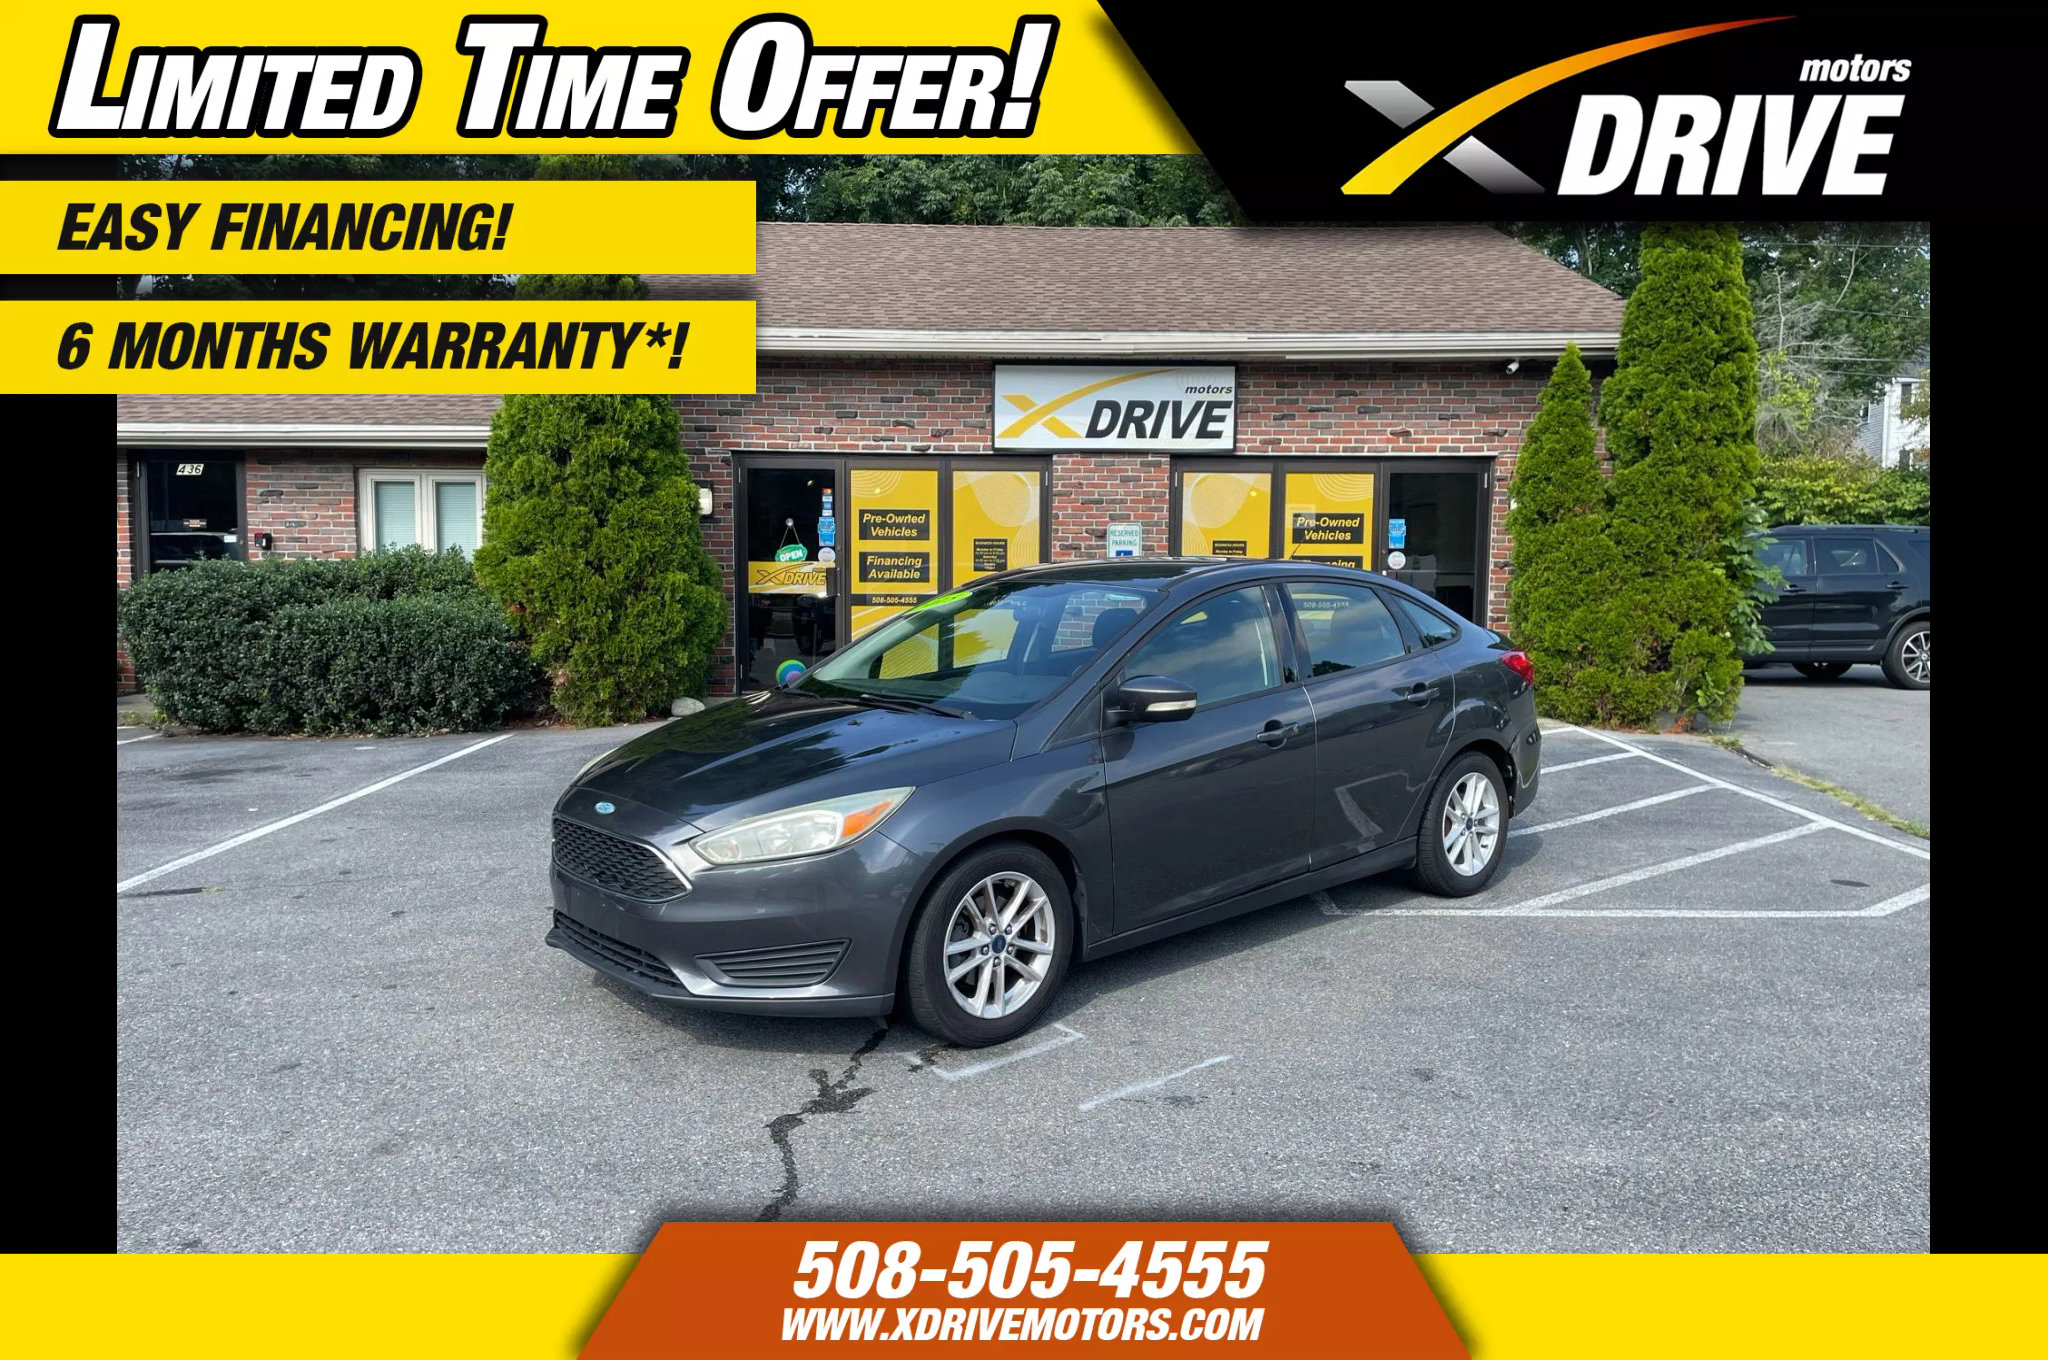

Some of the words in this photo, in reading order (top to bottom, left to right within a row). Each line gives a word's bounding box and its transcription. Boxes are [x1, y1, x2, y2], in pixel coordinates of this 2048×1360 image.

[1185, 384, 1233, 394] motors
[178, 464, 202, 474] 436
[863, 513, 925, 524] Pre-Owned
[1297, 517, 1361, 527] Pre-Owned
[871, 526, 918, 537] Vehicles
[1304, 530, 1351, 541] Vehicles
[780, 549, 804, 562] OPEN
[867, 556, 922, 568] Financing
[868, 569, 921, 579] Available
